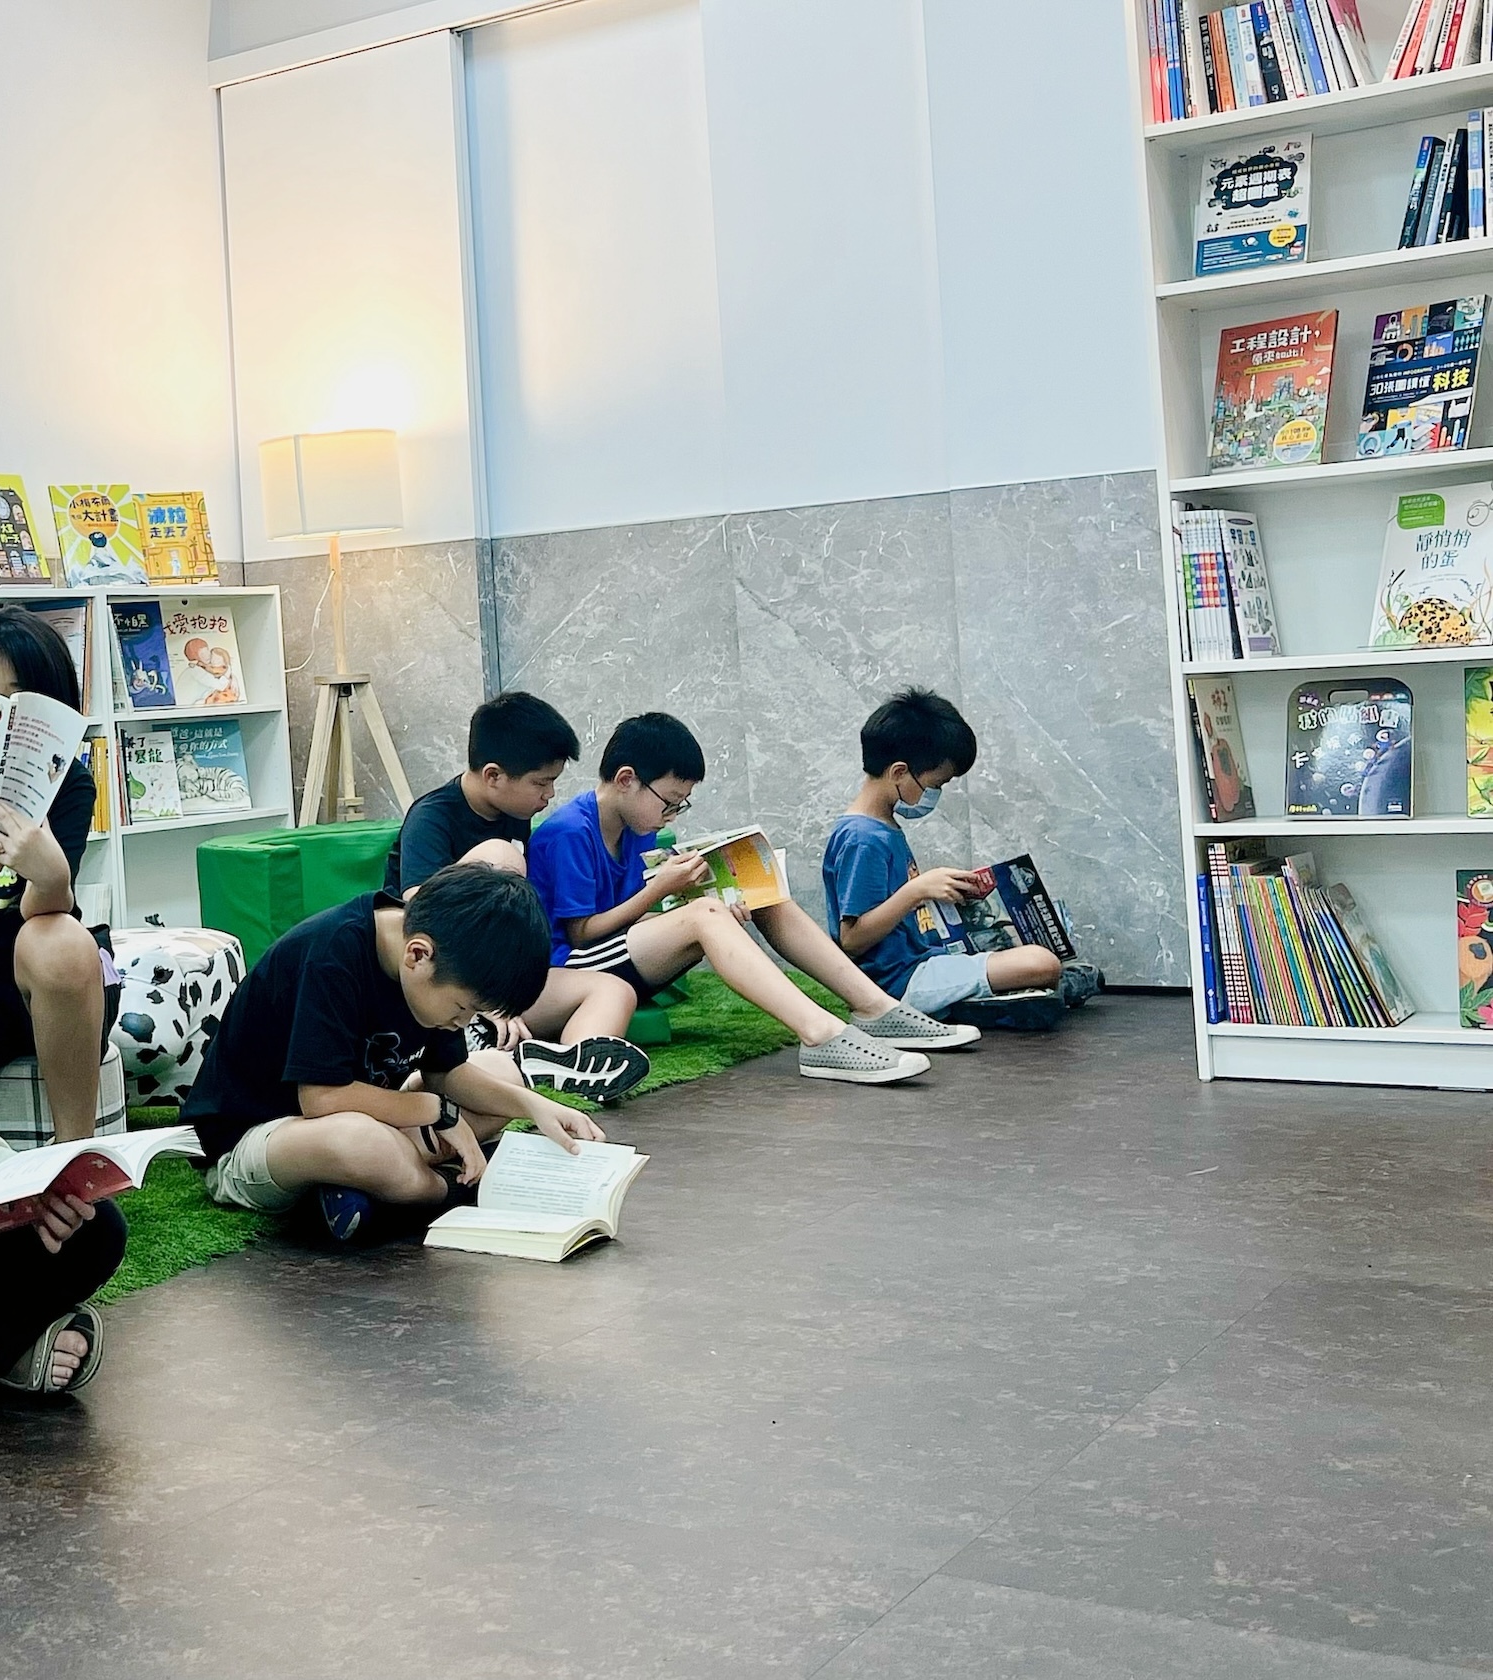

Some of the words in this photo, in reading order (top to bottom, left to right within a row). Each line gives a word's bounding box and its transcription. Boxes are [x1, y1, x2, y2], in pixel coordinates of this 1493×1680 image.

[1220, 167, 1292, 191] 元素週期表
[1432, 366, 1471, 392] 科技
[1415, 528, 1472, 553] 靜悄悄
[1421, 549, 1459, 571] 的蛋
[113, 613, 150, 628] 不怕黑
[163, 612, 230, 635] 我愛抱抱
